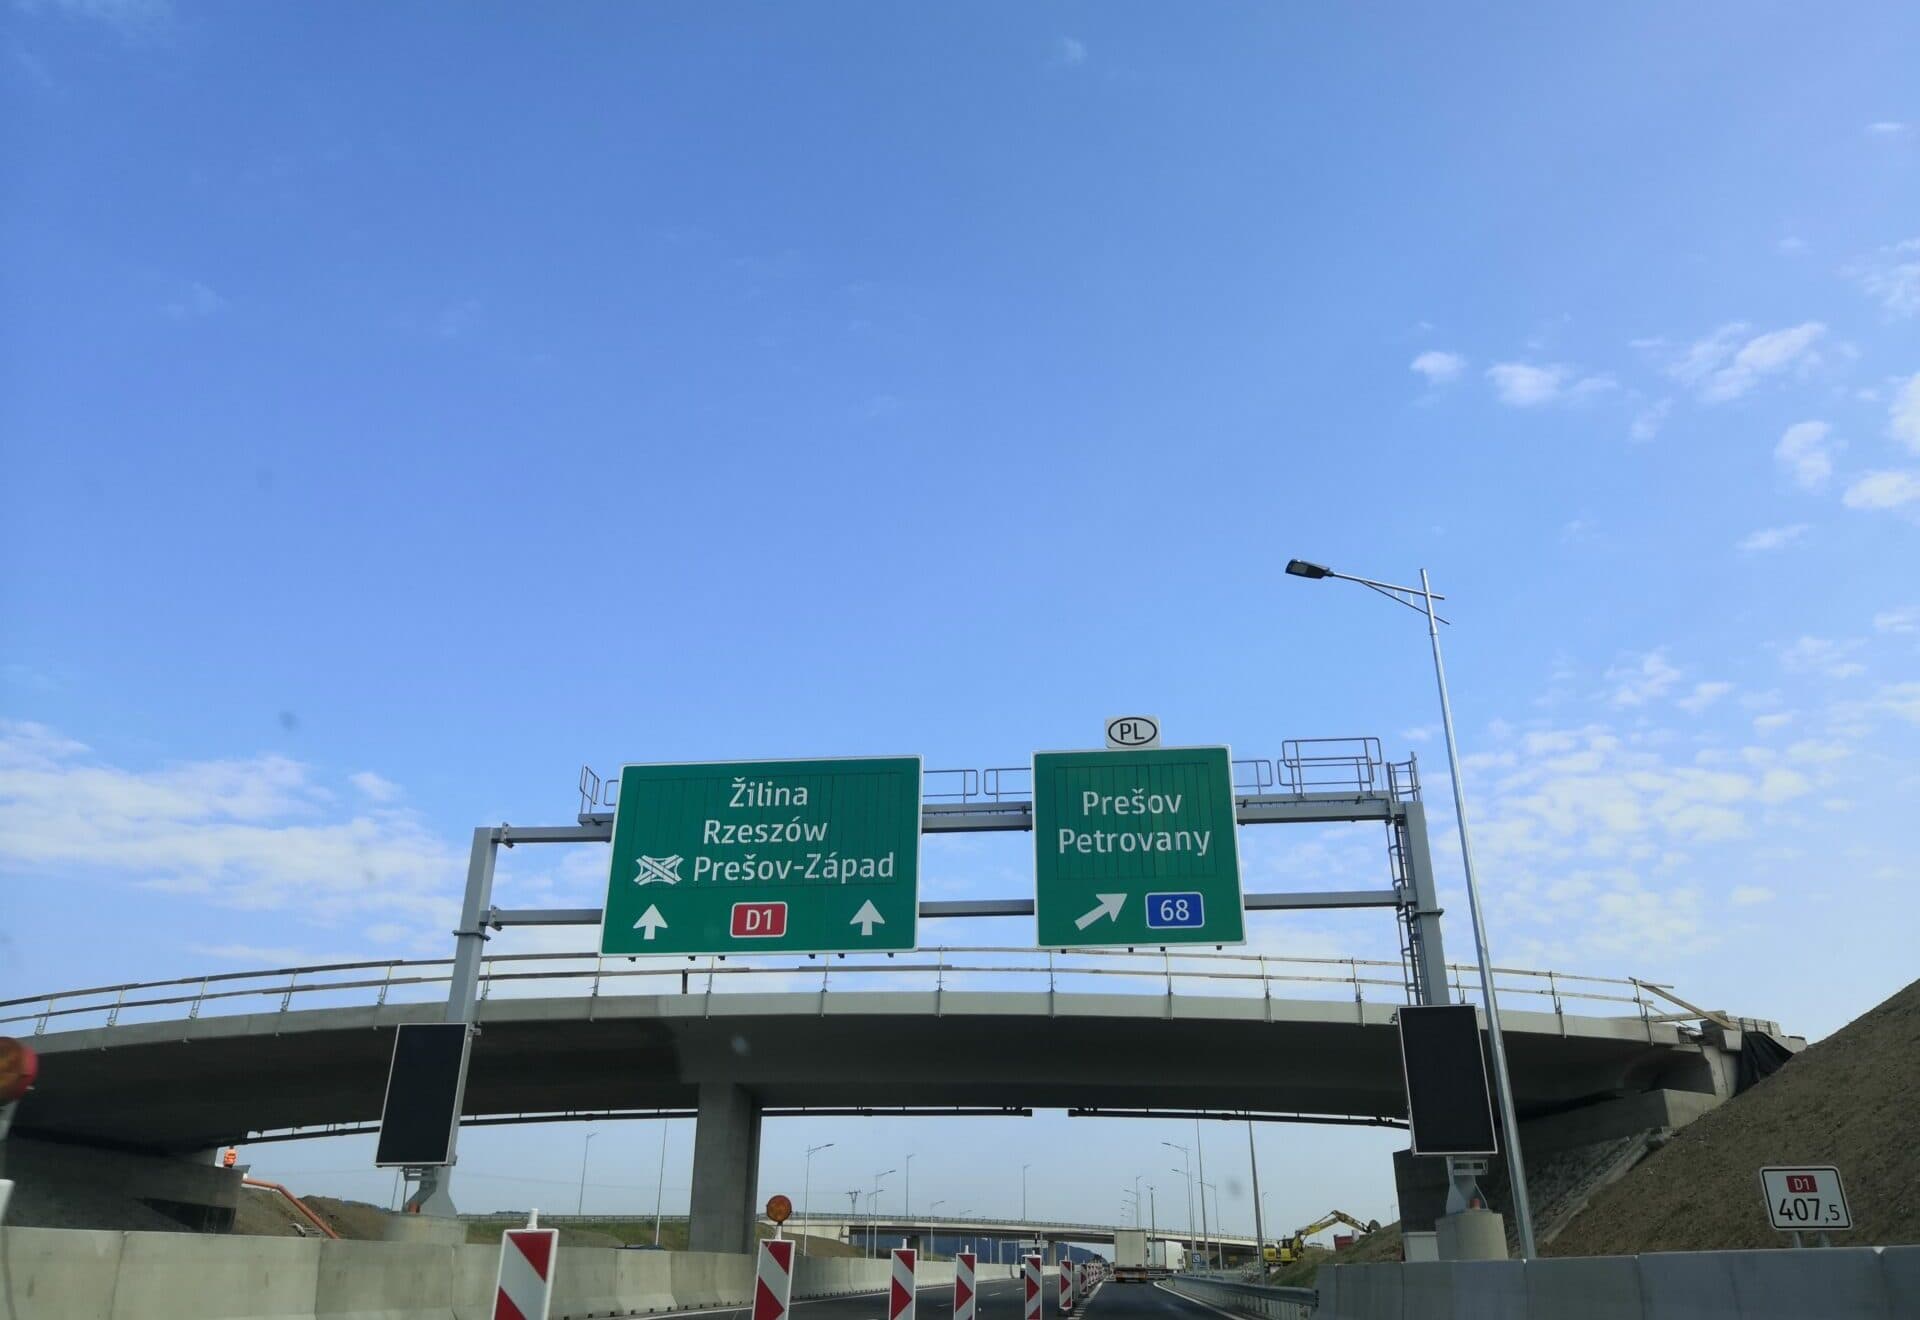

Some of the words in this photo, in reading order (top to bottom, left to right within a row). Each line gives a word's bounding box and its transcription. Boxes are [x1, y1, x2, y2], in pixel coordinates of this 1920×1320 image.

[1120, 723, 1145, 740] PL
[729, 777, 808, 808] Žilina
[1083, 788, 1182, 816] Prešov
[703, 816, 828, 845] Rzeszów
[1059, 828, 1211, 857] Petrovany
[693, 852, 894, 884] Prešov-Západ
[746, 909, 773, 931] D1
[1160, 899, 1190, 921] 68
[1794, 1178, 1810, 1190] D1
[1779, 1198, 1840, 1224] 407,5
